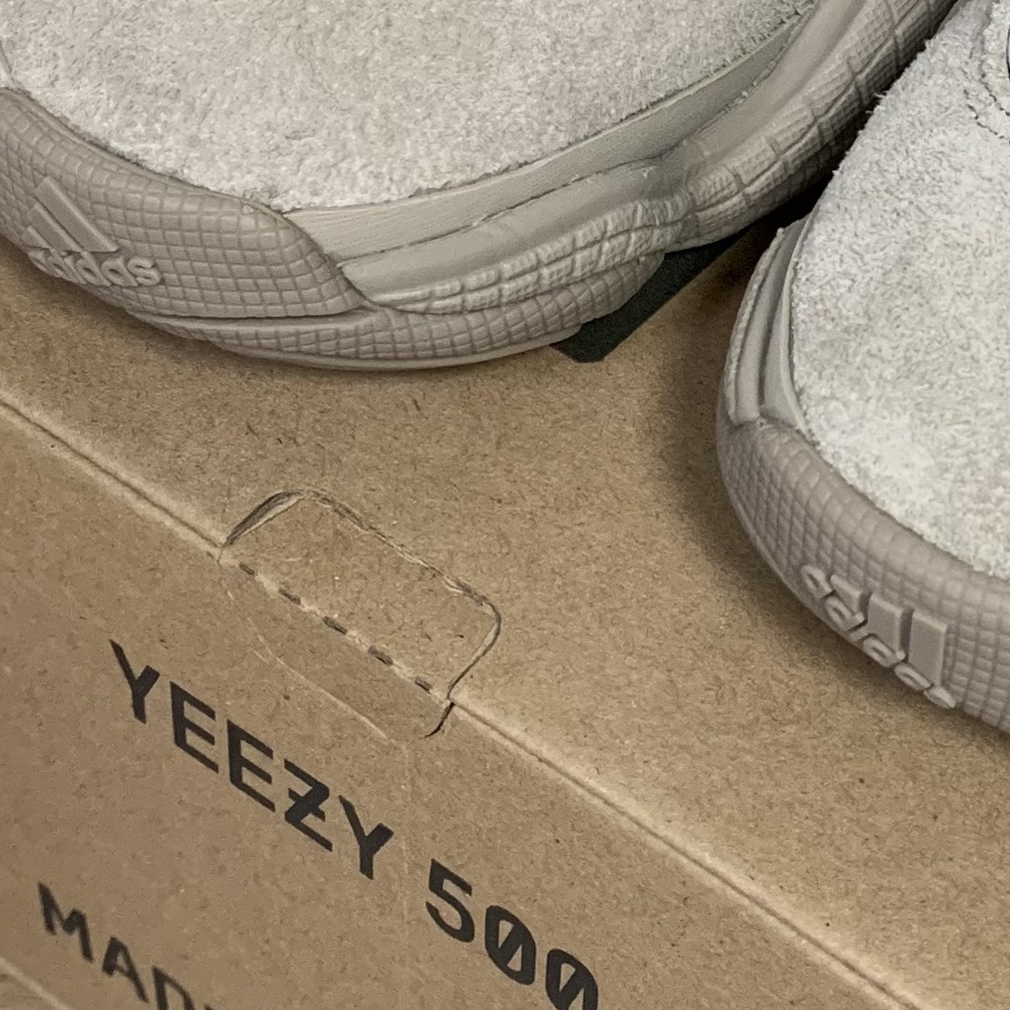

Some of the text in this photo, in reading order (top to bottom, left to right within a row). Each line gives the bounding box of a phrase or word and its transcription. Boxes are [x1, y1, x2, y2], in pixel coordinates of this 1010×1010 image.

[37, 881, 215, 1010] MAD
[110, 639, 599, 1010] YEEZY 500
